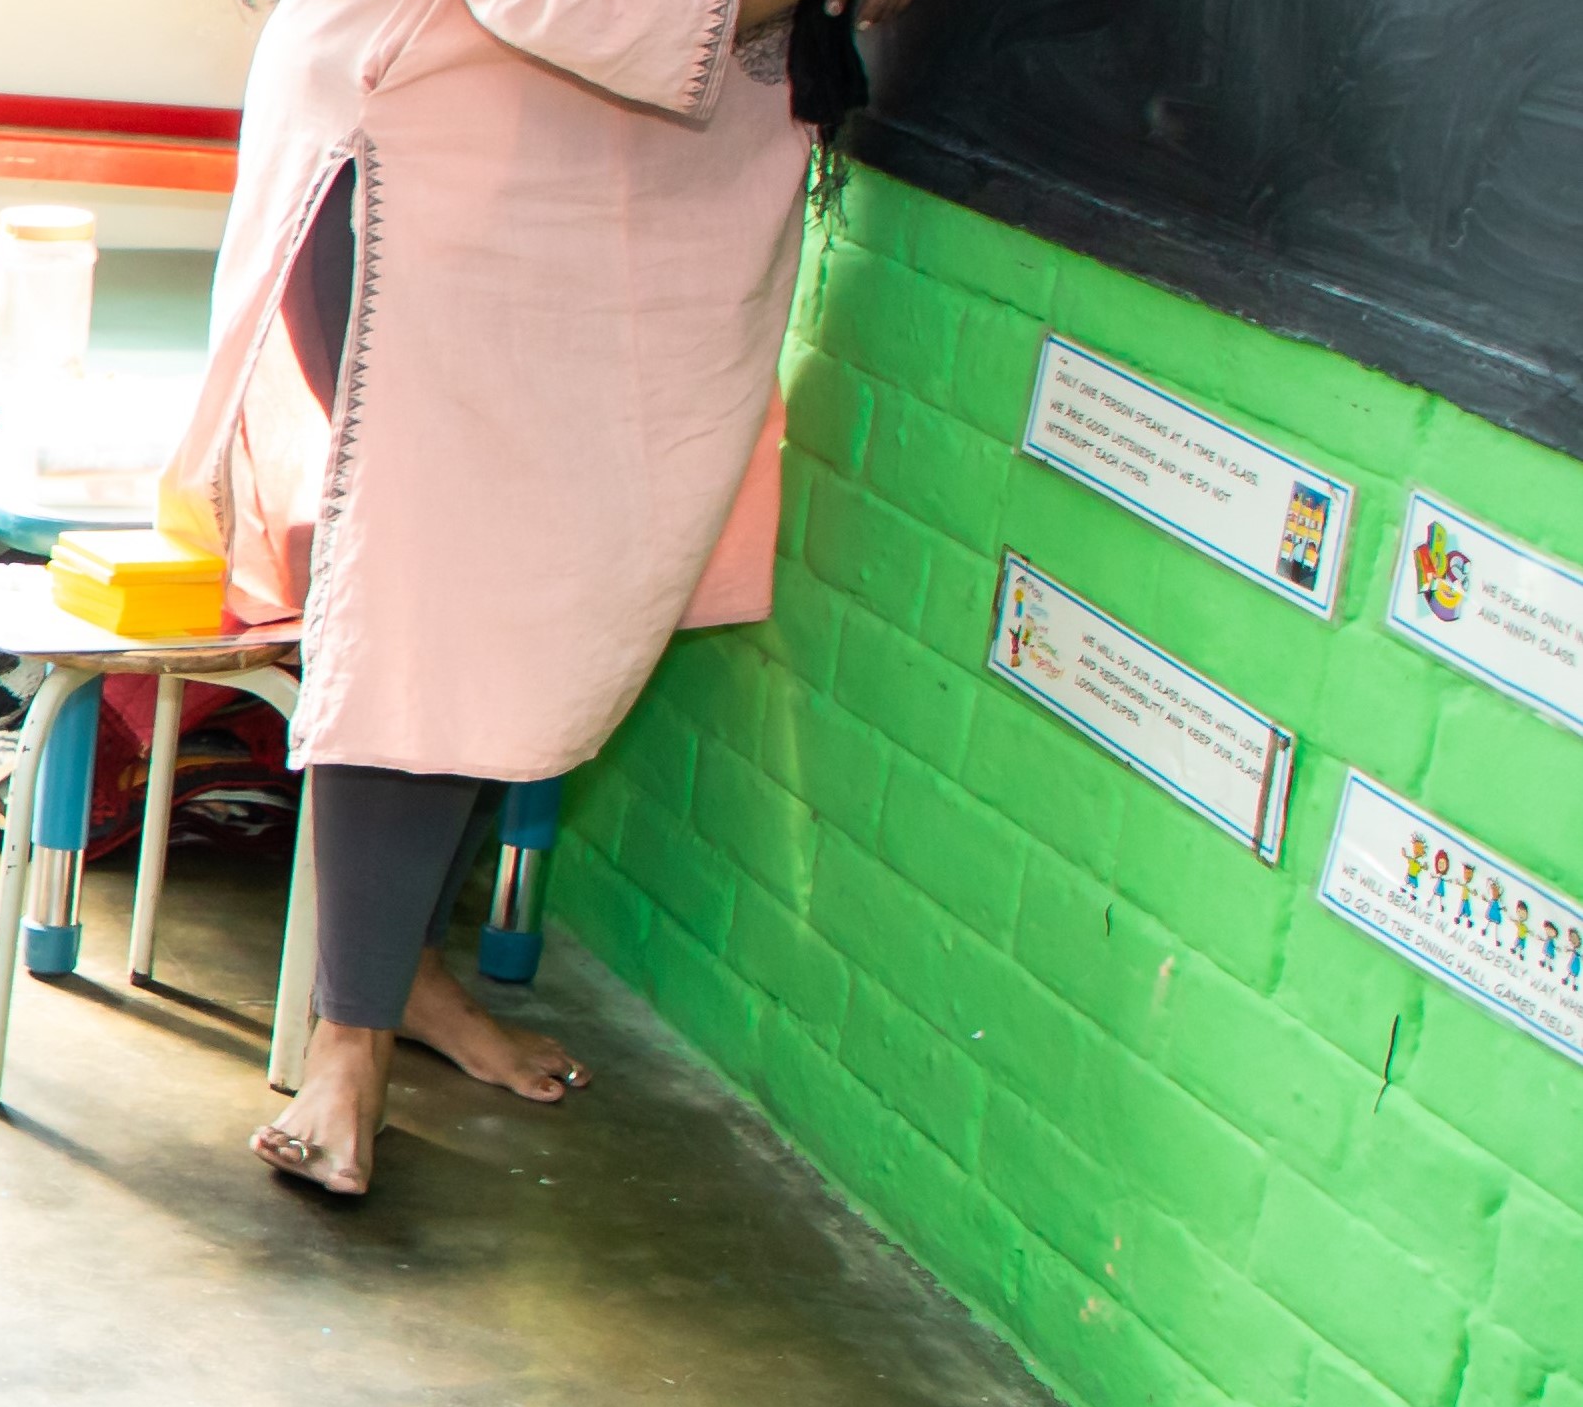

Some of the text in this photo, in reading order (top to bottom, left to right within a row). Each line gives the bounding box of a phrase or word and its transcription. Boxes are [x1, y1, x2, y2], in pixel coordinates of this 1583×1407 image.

[1044, 420, 1095, 454] INTERRUPT
[1093, 447, 1121, 469] EACH
[1049, 398, 1233, 504] WE ARE GOOD LISTENERS AND WE DO NOT
[1055, 369, 1079, 389] ONLY
[1078, 381, 1098, 401] ONE
[1099, 392, 1135, 419] PERSON
[1132, 411, 1169, 439] SPEAKS
[1169, 430, 1183, 443] AT
[1182, 438, 1192, 450] A
[1193, 443, 1216, 464] TIME
[1216, 455, 1228, 470] IN
[1477, 605, 1501, 626] AND
[1502, 618, 1537, 646] HINDI
[1481, 578, 1499, 600] WE
[1499, 590, 1538, 620] SPEAK
[1540, 611, 1574, 635] ONLY
[1074, 673, 1111, 707] LOOKING
[1077, 653, 1097, 672] AND
[1097, 666, 1166, 718] RESPONSIBILITY
[1164, 711, 1185, 730] AND
[1187, 725, 1213, 747] KEEP
[1212, 742, 1233, 765] OUR
[1081, 631, 1263, 759] WE WILL DO OUR CLASS DUTIES WITH LOVE
[1338, 886, 1351, 903] TO
[1353, 897, 1369, 915] GO
[1371, 907, 1388, 926] TO
[1390, 918, 1411, 941] THE
[1414, 933, 1454, 966] DINING
[1493, 982, 1538, 1017] GAMES
[1340, 861, 1358, 882] WE
[1358, 871, 1384, 898] WILL
[1386, 890, 1432, 926] BEHAVE
[1434, 917, 1447, 935] IN
[1448, 929, 1467, 947] AN
[1466, 939, 1528, 980] ORDERLY
[1528, 976, 1558, 998] WAY
